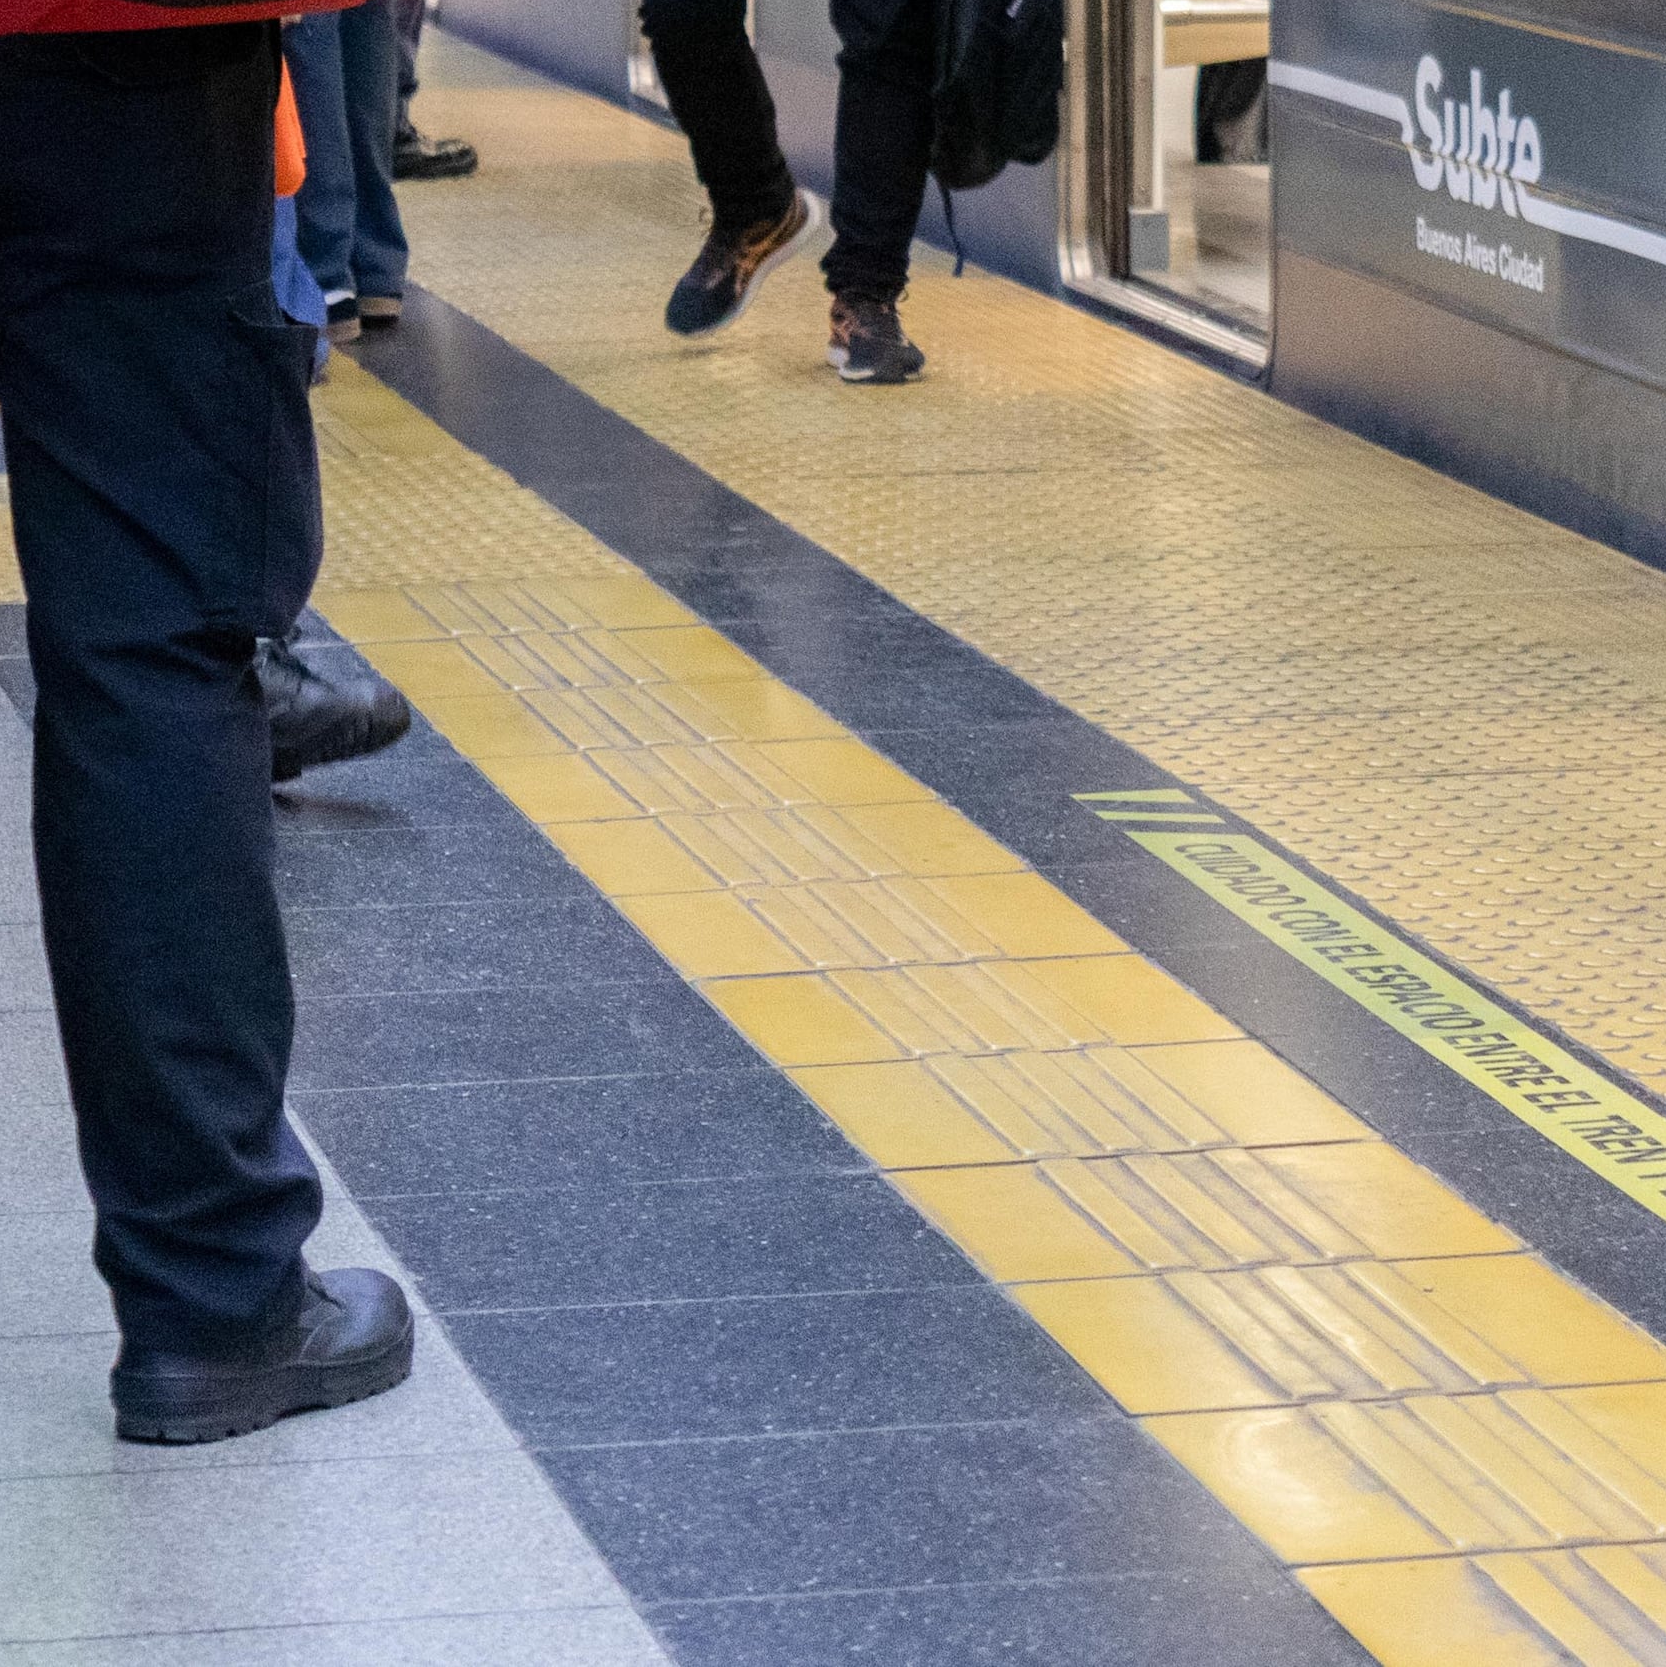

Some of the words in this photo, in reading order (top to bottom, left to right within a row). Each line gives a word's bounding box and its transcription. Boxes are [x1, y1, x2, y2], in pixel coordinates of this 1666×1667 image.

[1412, 54, 1542, 221] Subte
[1463, 232, 1498, 277] Aires
[1497, 243, 1544, 293] Ciudad
[1174, 843, 1307, 906] CUIDADO
[1267, 910, 1360, 943] CON
[1313, 943, 1386, 964] EL
[1342, 964, 1485, 1030] ESPACIO
[1444, 1031, 1571, 1089] ENTRE
[1522, 1089, 1601, 1114] EL
